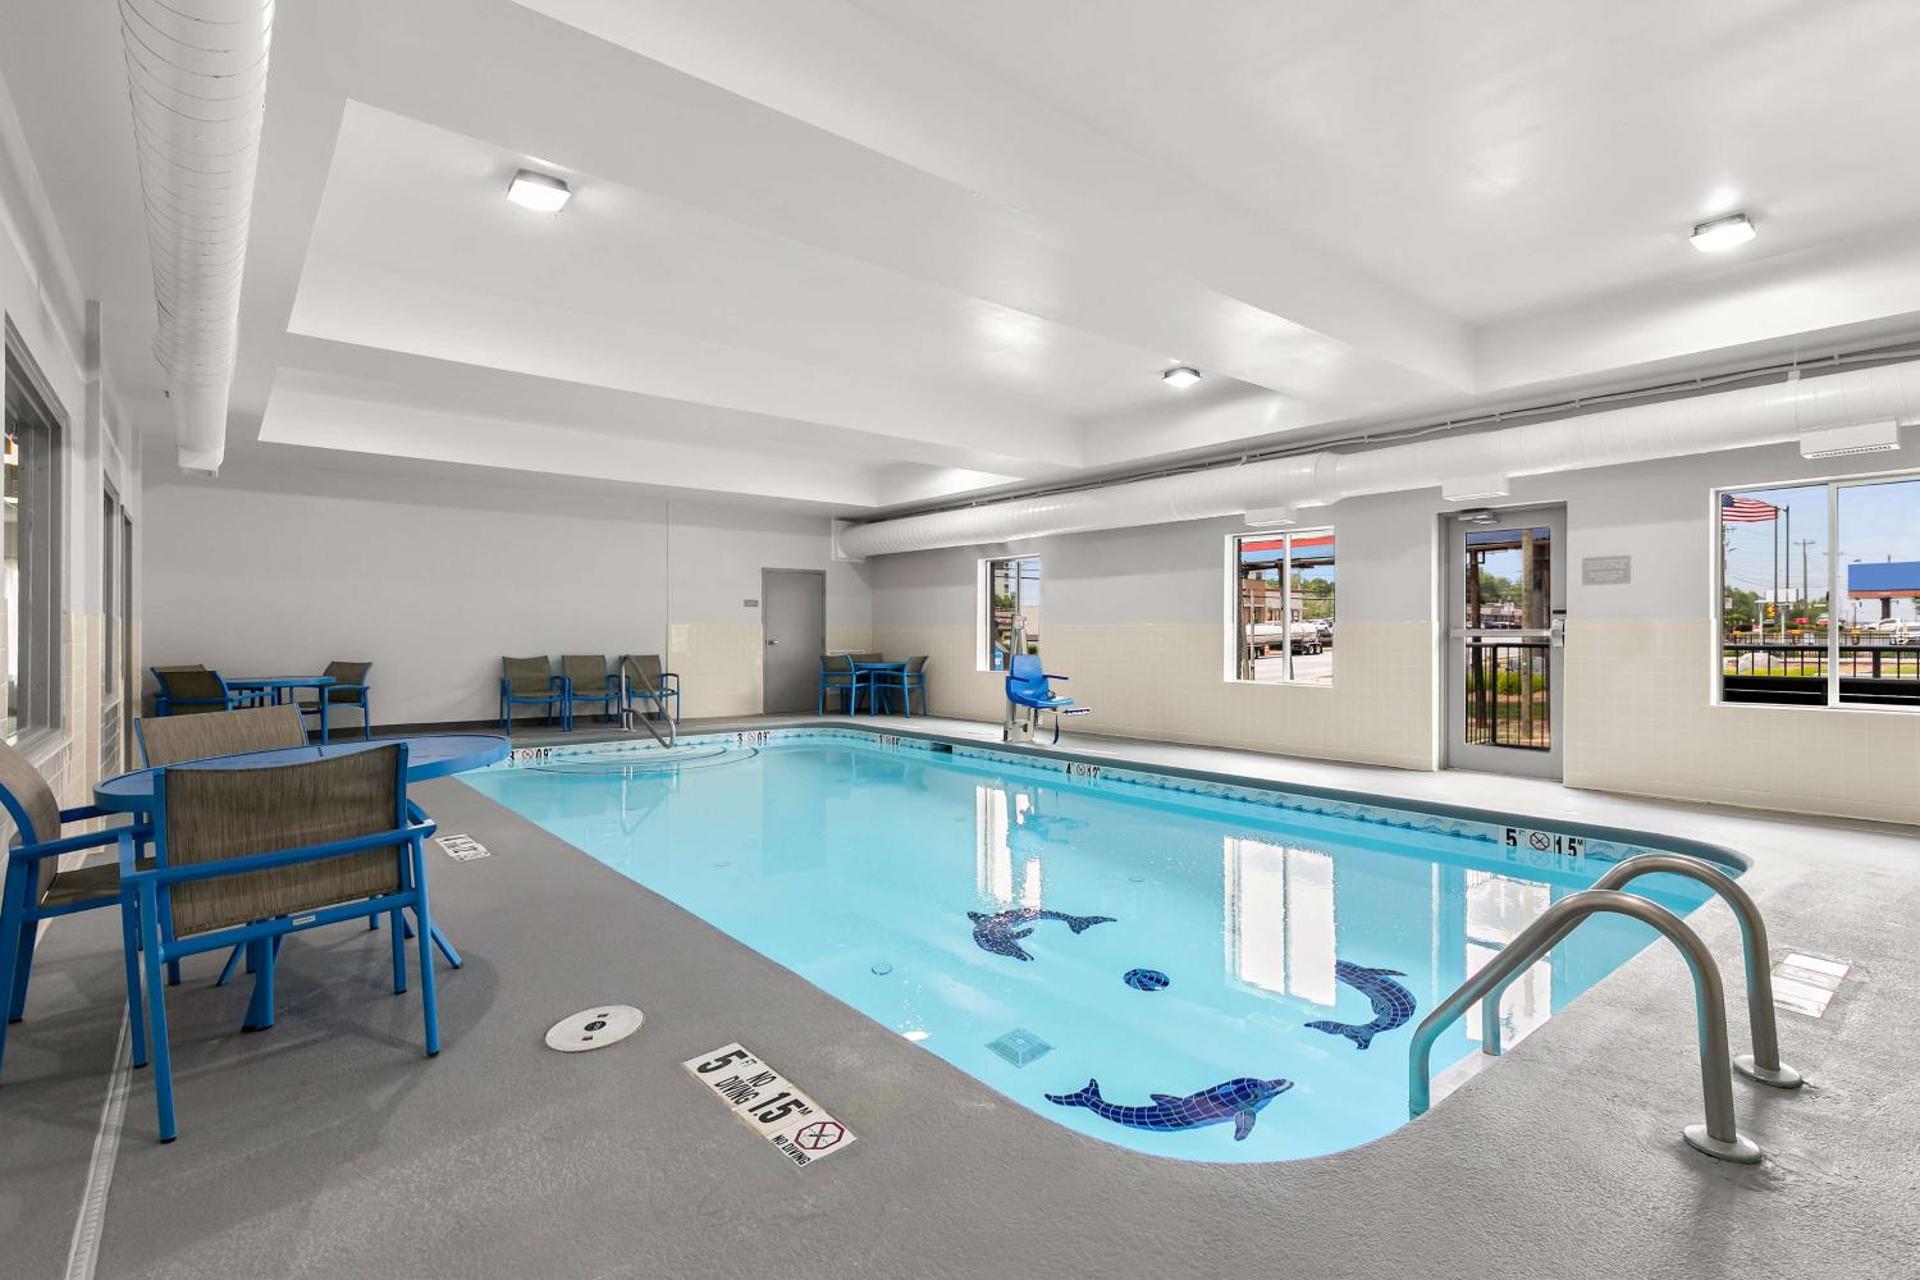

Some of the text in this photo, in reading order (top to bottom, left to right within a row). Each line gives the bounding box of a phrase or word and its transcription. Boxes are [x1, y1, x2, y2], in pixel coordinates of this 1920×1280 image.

[714, 1075, 760, 1105] DIVING
[746, 1071, 777, 1088] NO
[772, 1134, 812, 1166] NO DIVING
